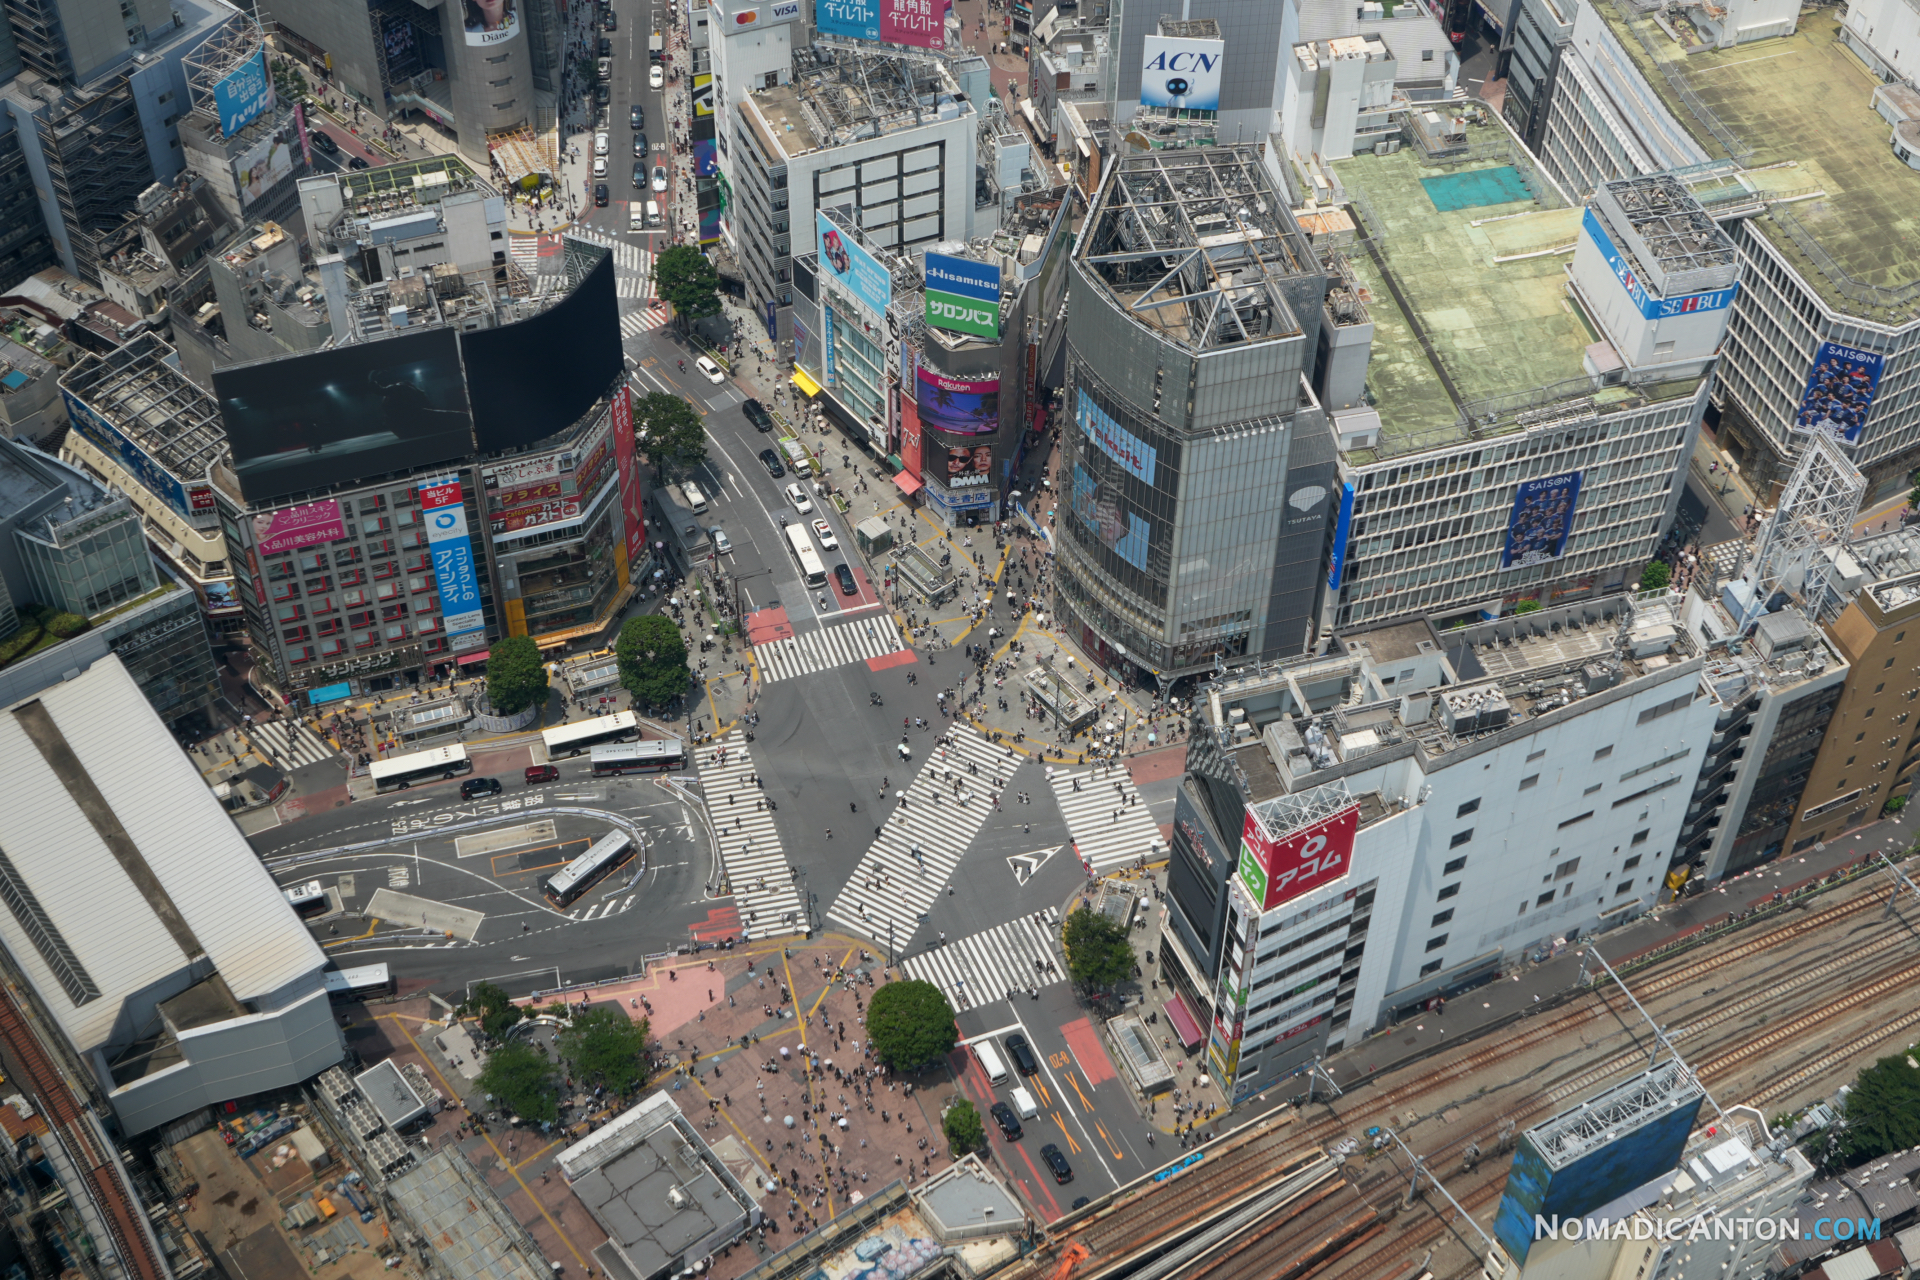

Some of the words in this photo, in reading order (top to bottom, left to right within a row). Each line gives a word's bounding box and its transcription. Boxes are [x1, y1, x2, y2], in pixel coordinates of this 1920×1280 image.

[773, 5, 798, 17] VISA
[1144, 50, 1221, 74] ACN
[926, 267, 998, 290] Hisamitsu
[1660, 293, 1723, 316] SEIBU
[930, 300, 994, 328] サロンパス
[1828, 346, 1877, 365] SAISON
[938, 379, 971, 393] Rakuten
[484, 477, 496, 485] 9F
[950, 474, 989, 488] DMM
[1528, 475, 1573, 492] SAISON
[427, 487, 454, 498] 当ビル
[435, 496, 449, 505] 5F
[491, 521, 505, 531] 7F
[525, 511, 559, 526] ガスト
[1288, 514, 1322, 525] TSUTAYA
[432, 527, 463, 539] eyecity
[436, 549, 460, 604] アイシティ
[455, 546, 475, 601] コンタクトの
[1179, 632, 1248, 652] STARBUCKS
[326, 655, 392, 678] サンドラッグ
[1247, 826, 1268, 865] アコム
[1241, 848, 1260, 890] レイク
[1276, 850, 1342, 892] アコム
[1049, 1051, 1070, 1069] 8-20
